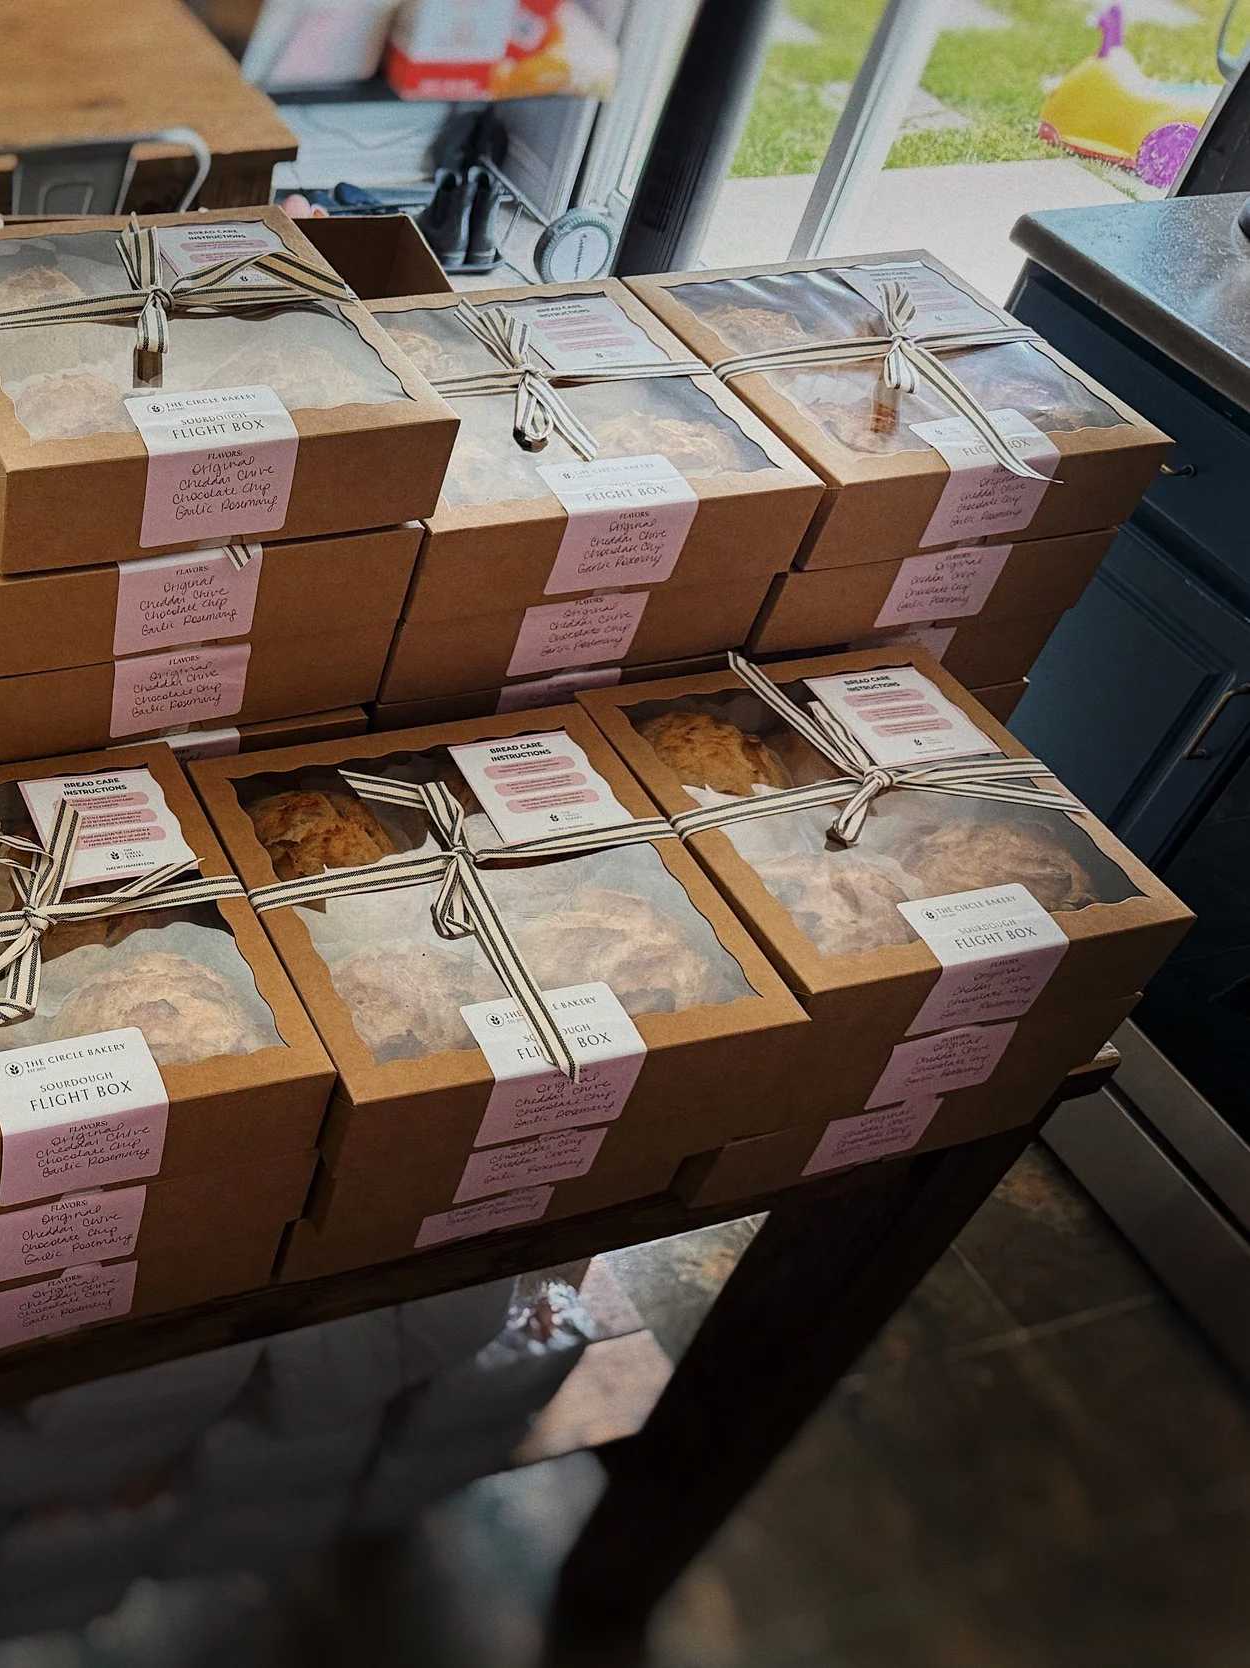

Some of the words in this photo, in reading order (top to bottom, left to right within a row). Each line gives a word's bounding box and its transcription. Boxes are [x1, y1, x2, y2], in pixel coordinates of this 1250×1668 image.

[187, 398, 219, 406] CIRCLE
[222, 393, 256, 402] BAKERY
[172, 424, 226, 439] FLIGHT
[233, 419, 265, 432] BOX
[181, 413, 247, 425] SOURDOUGH
[208, 450, 243, 460] FLAVORS:
[192, 456, 255, 477] Original
[179, 474, 231, 491] Cheddar
[237, 466, 274, 481] Chive
[172, 488, 237, 505] Chocolate
[242, 479, 270, 496] Chip
[585, 490, 633, 502] FLIGHT
[640, 485, 668, 496] BOX
[176, 503, 213, 520] Garlic
[220, 496, 278, 512] Rosemary
[176, 566, 209, 576] FLAVORS:
[163, 576, 214, 595] Original
[140, 596, 185, 611] Cheddar
[193, 587, 229, 599] Chive
[141, 622, 174, 636] Garlic
[183, 609, 237, 625] Rosemary
[144, 605, 197, 621] Chocolate
[847, 682, 900, 692] INSTRUCTIONS
[489, 744, 519, 754] BREAD
[520, 742, 543, 750] CARE
[491, 749, 552, 762] INSTRUCTIONS
[63, 784, 128, 796] INSTRUCTIONS
[936, 906, 952, 914] THE
[954, 901, 984, 912] CIRCLE
[985, 895, 1017, 906] BAKERY
[958, 919, 1017, 935] SOURDOUGH
[955, 931, 1004, 950] FLIGHT
[1005, 926, 1038, 940] BOX
[561, 996, 597, 1009] BAKERY
[577, 1032, 612, 1048] BOX
[24, 1058, 45, 1070] THE
[48, 1051, 85, 1064] CIRCLE
[87, 1043, 126, 1056] BAKERY
[40, 1072, 114, 1093] SOURDOUGH
[30, 1089, 92, 1112] FLIGHT
[97, 1080, 133, 1098] BOX
[51, 1122, 124, 1147] Original
[69, 1120, 108, 1134] FLAVORS:
[36, 1140, 99, 1159] Cheddar
[106, 1127, 151, 1142] Chive
[37, 1148, 105, 1168] Chocolate
[110, 1139, 142, 1151] Chip
[42, 1162, 83, 1178] Garlic
[88, 1148, 150, 1167] Rosemary
[42, 1205, 102, 1225] Original
[50, 1199, 88, 1211] FLAVORS:
[22, 1226, 73, 1241] Cheddar
[82, 1213, 123, 1227] Chive
[21, 1235, 80, 1253] Chocolate
[87, 1227, 118, 1238] Chip
[24, 1252, 63, 1266] Garlic
[72, 1233, 133, 1252] Rosemary
